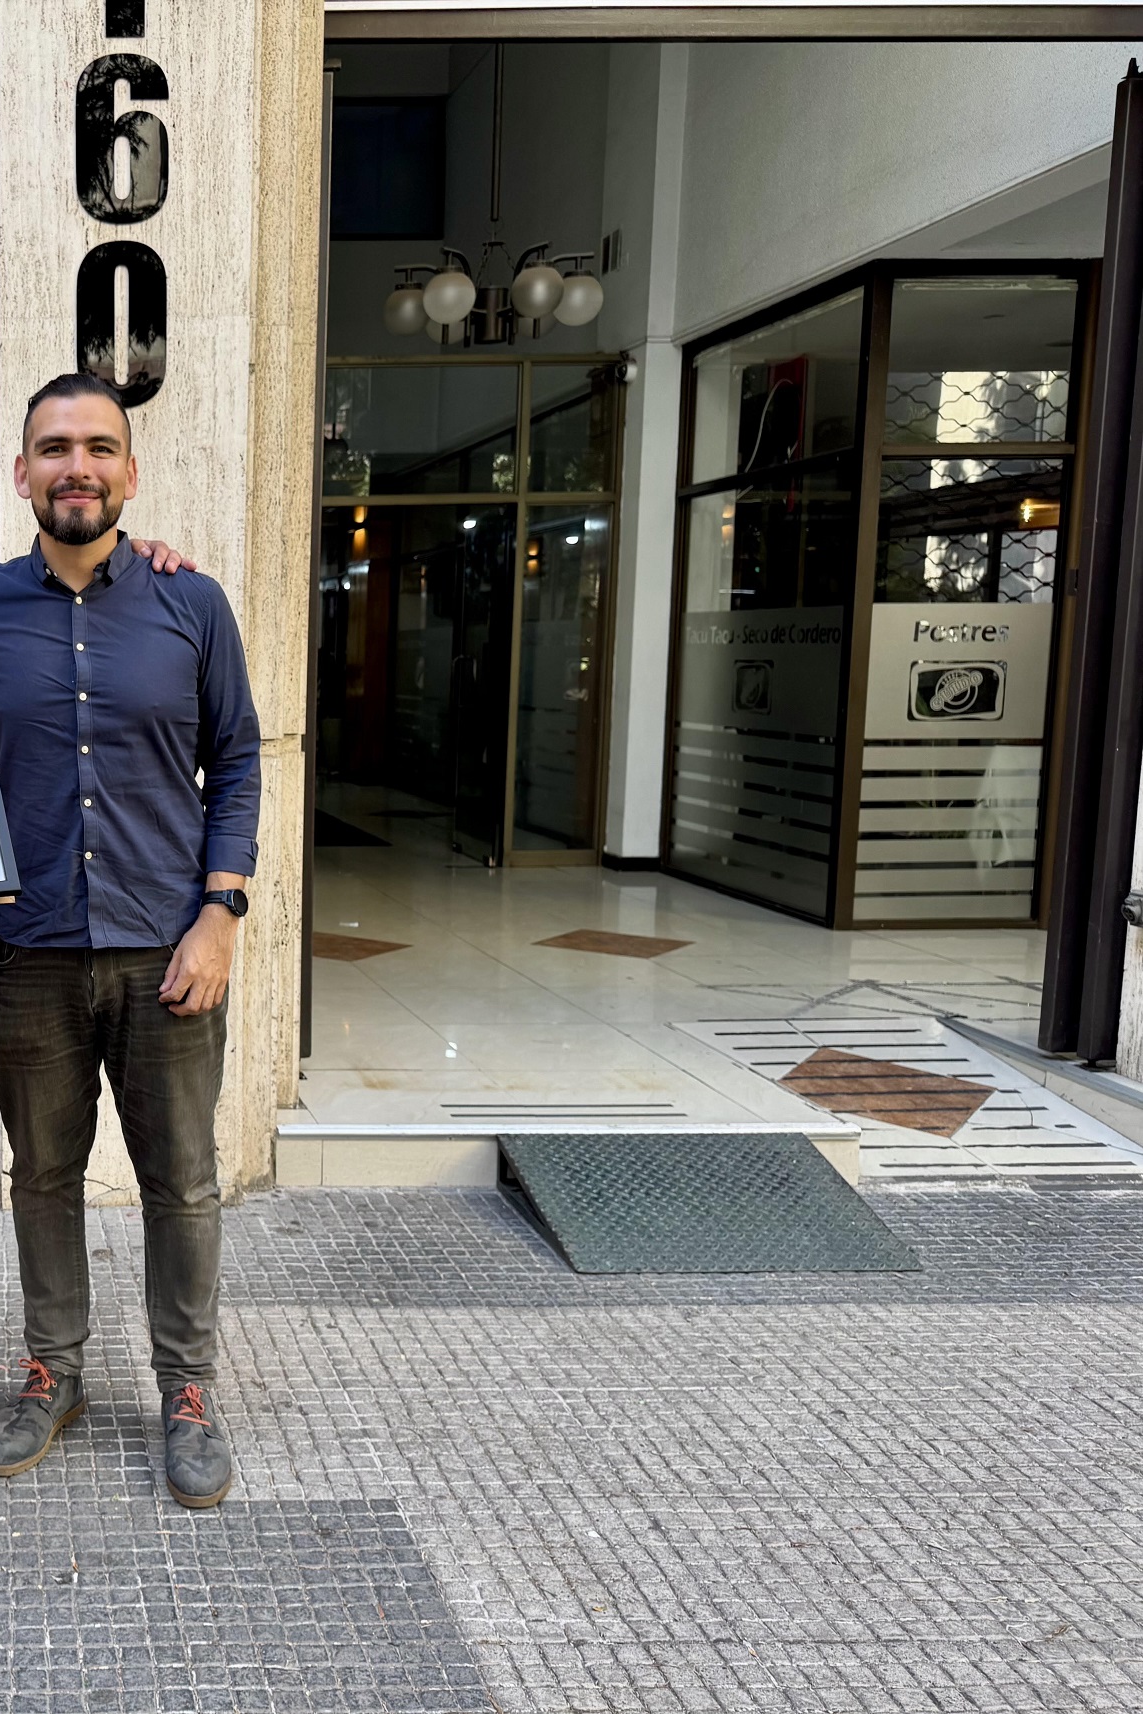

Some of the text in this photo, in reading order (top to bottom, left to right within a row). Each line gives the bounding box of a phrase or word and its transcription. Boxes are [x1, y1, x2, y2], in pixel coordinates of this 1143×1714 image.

[76, 0, 169, 409] 60
[742, 624, 768, 645] Seco
[770, 623, 786, 645] de
[788, 622, 842, 645] Cordero
[913, 620, 1010, 643] Postres
